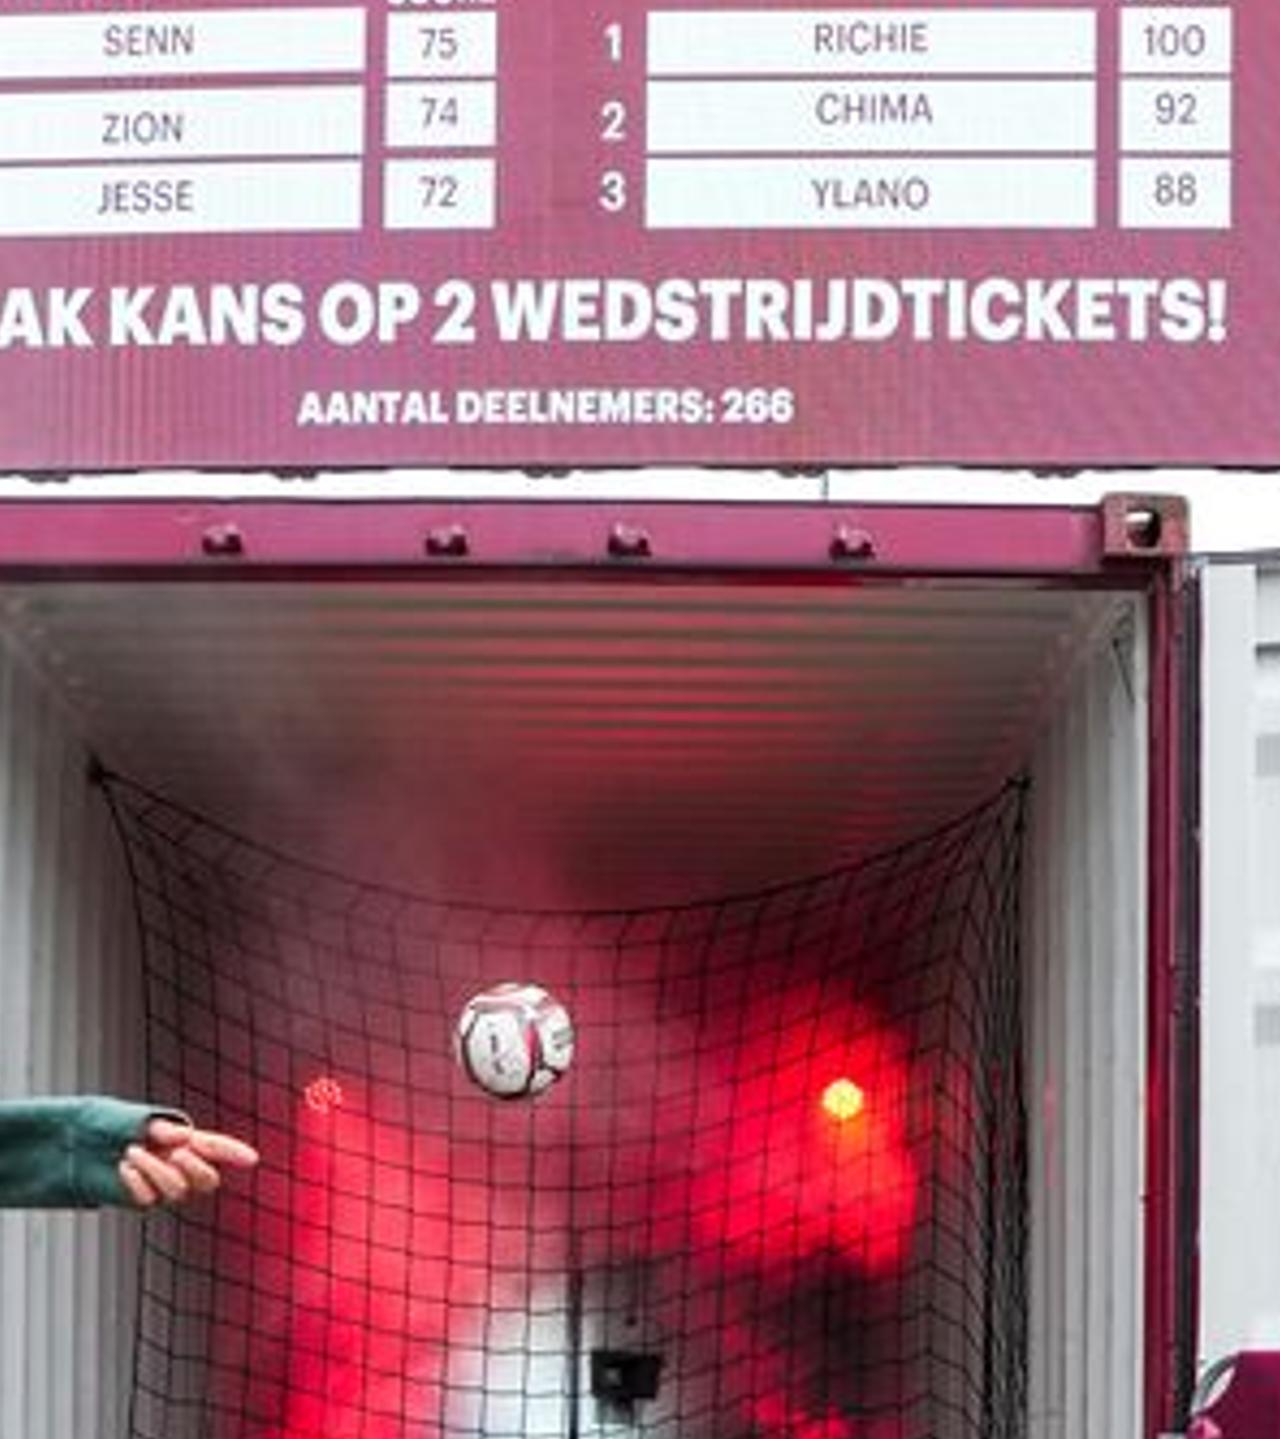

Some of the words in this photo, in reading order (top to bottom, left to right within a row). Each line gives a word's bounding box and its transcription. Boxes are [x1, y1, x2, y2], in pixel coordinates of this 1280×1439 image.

[104, 24, 194, 57] SENN
[419, 27, 458, 60] 75
[606, 23, 622, 61] 1
[814, 20, 928, 56] RICHIE
[1143, 24, 1206, 57] 100
[101, 111, 184, 145] ZION
[421, 96, 459, 126] 74
[602, 101, 626, 140] 2
[815, 92, 933, 126] CHIMA
[1155, 91, 1197, 126] 92
[98, 179, 193, 215] JESSE
[420, 175, 458, 208] 72
[600, 171, 626, 211] 3
[811, 176, 930, 211] YLANO
[1153, 172, 1197, 207] 88
[109, 282, 306, 346] KANS
[318, 281, 421, 345] OP
[433, 279, 476, 343] 2
[490, 277, 1226, 342] WEDSTRIJDTICKETS!
[297, 390, 449, 424] AANTAL
[456, 388, 714, 424] DEELNEMERS:
[721, 387, 794, 423] 266
